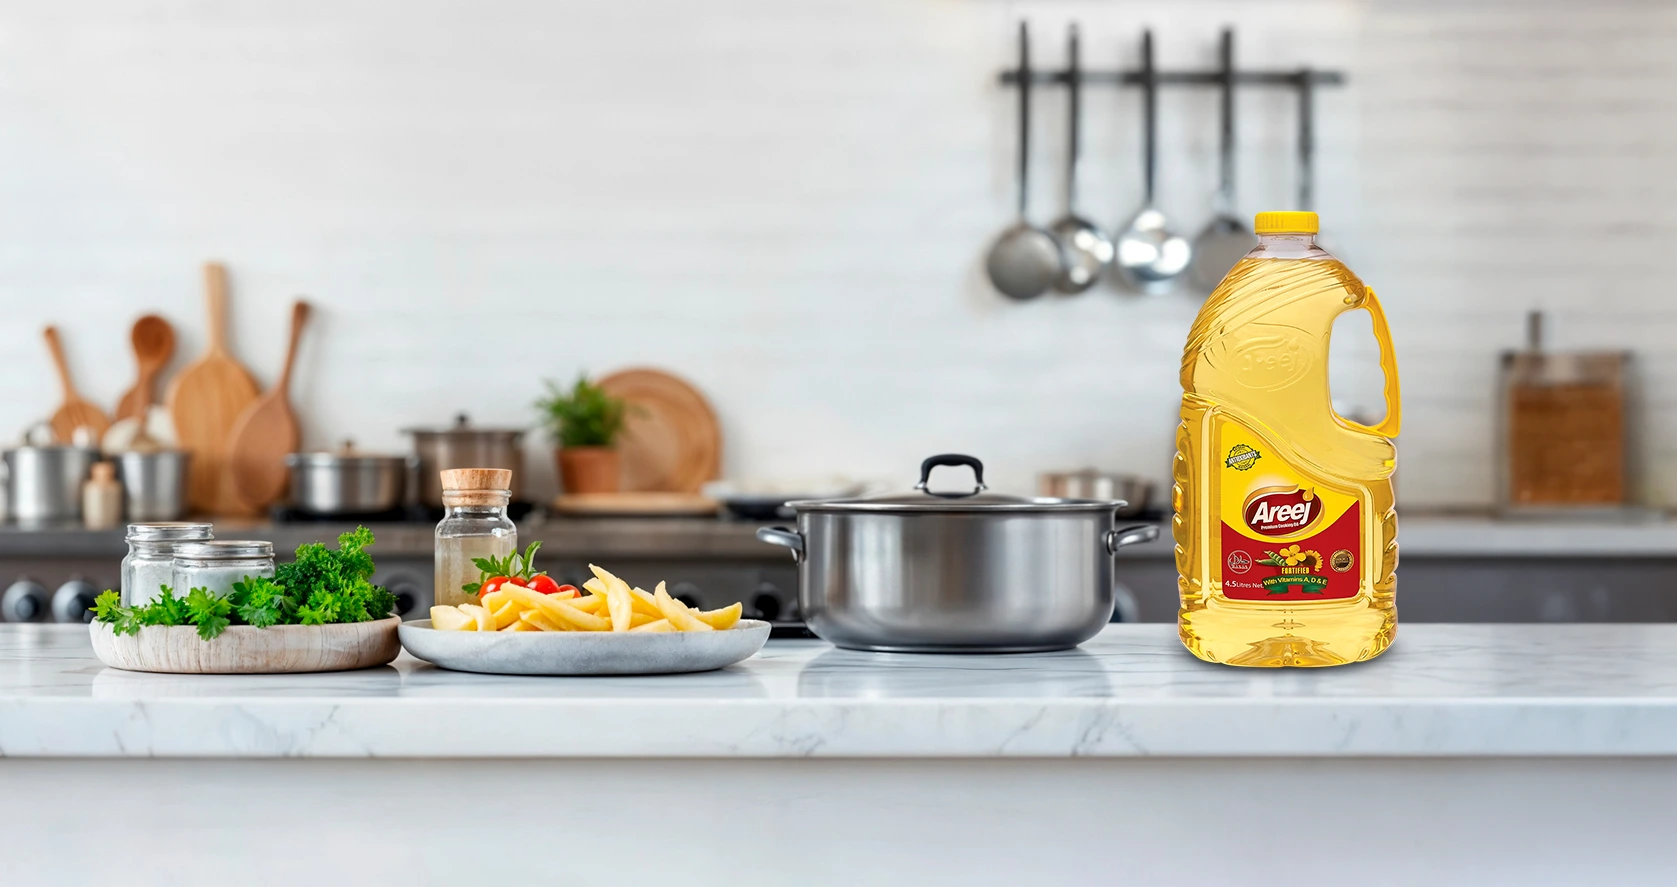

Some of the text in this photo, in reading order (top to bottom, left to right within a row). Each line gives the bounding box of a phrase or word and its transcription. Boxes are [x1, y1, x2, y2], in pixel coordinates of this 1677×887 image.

[1250, 501, 1312, 525] Areej
[1281, 567, 1310, 575] FORTIFIED
[1262, 578, 1278, 586] With
